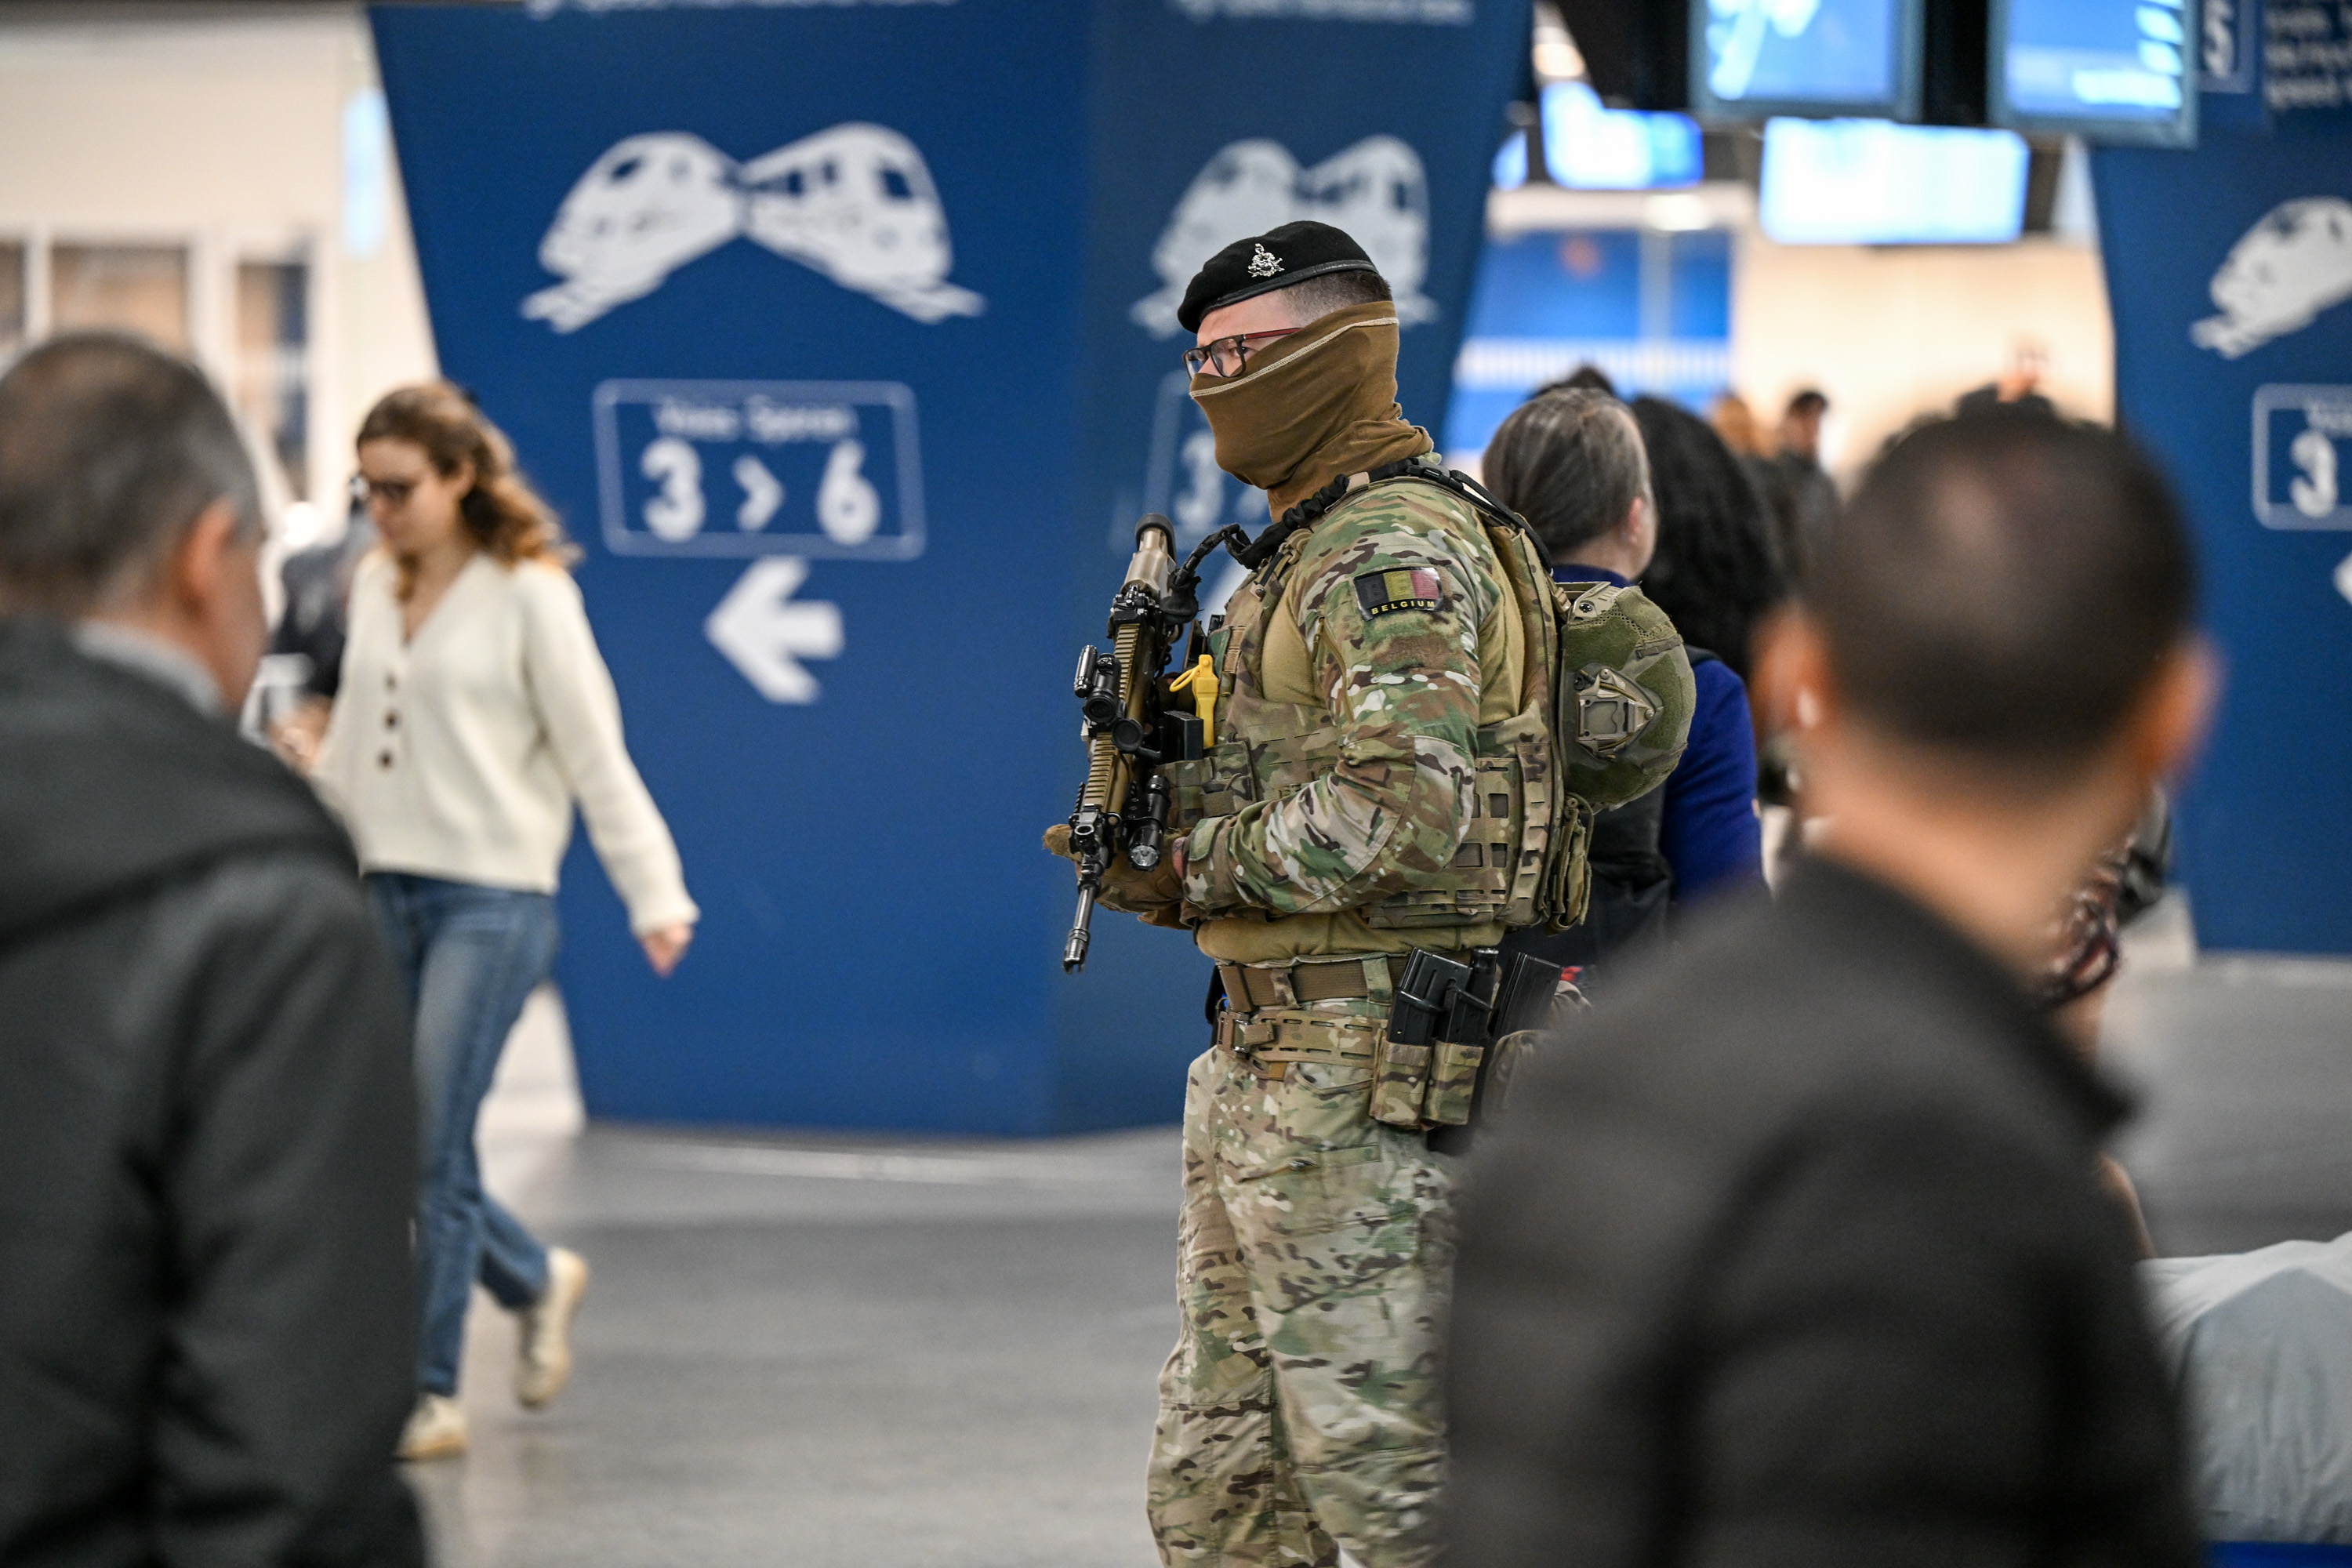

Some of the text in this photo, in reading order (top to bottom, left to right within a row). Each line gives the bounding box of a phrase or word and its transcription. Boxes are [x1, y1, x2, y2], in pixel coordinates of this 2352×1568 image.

[642, 438, 705, 542] 3
[818, 441, 880, 546] 6
[1372, 601, 1435, 615] BELGIUM
